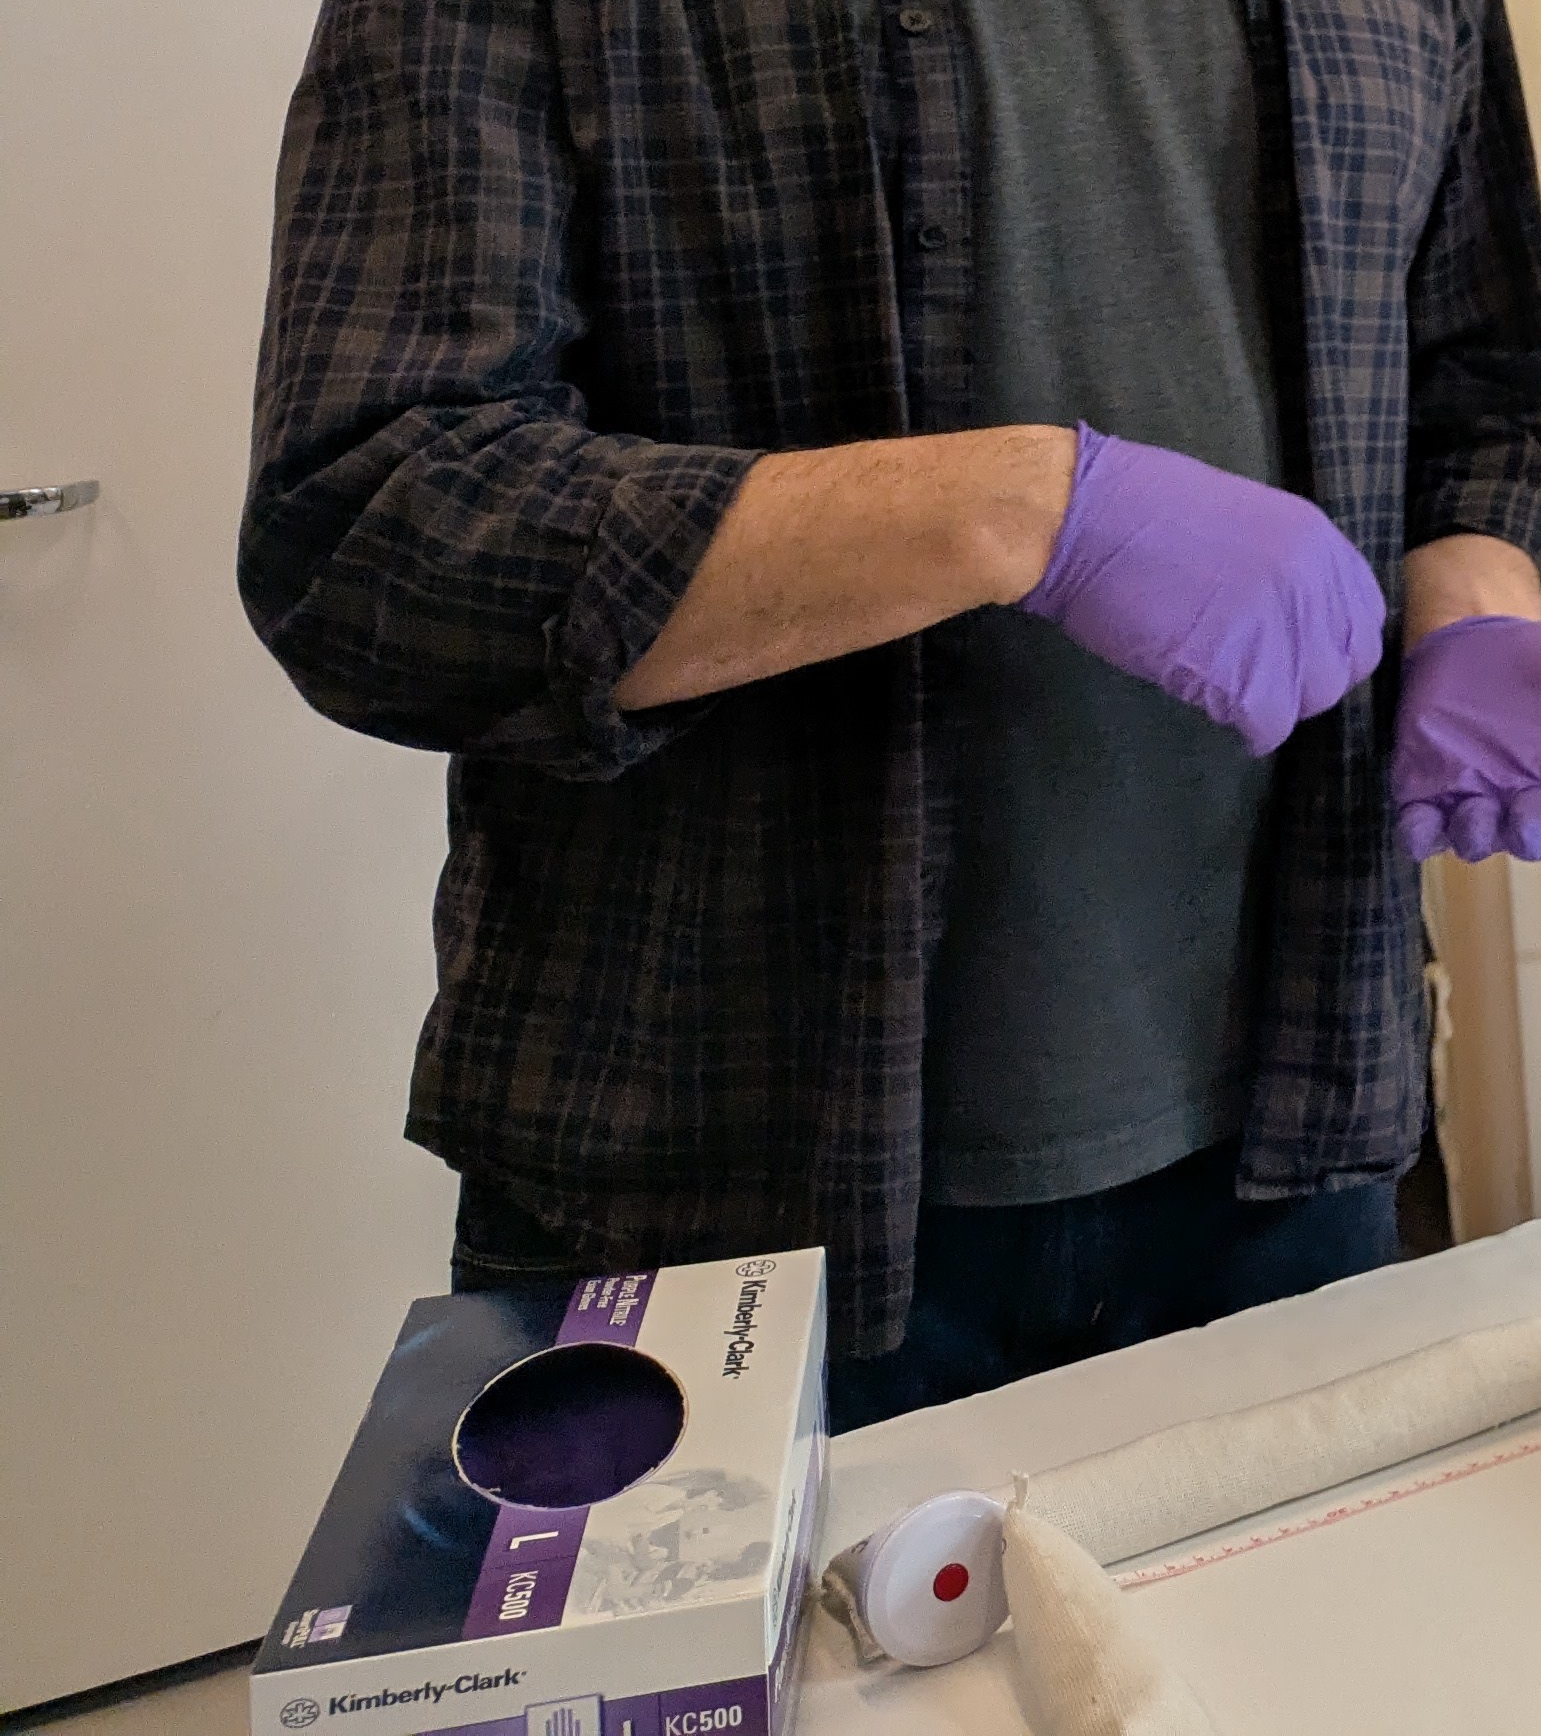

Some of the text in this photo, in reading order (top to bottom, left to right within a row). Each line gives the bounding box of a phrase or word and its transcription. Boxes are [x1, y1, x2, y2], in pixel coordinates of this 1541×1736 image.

[722, 1279, 768, 1378] Kimberly-Clark
[509, 1531, 559, 1550] L
[499, 1570, 539, 1620] KC500
[329, 1668, 521, 1716] Kimberly-Clark
[665, 1705, 743, 1736] KC500
